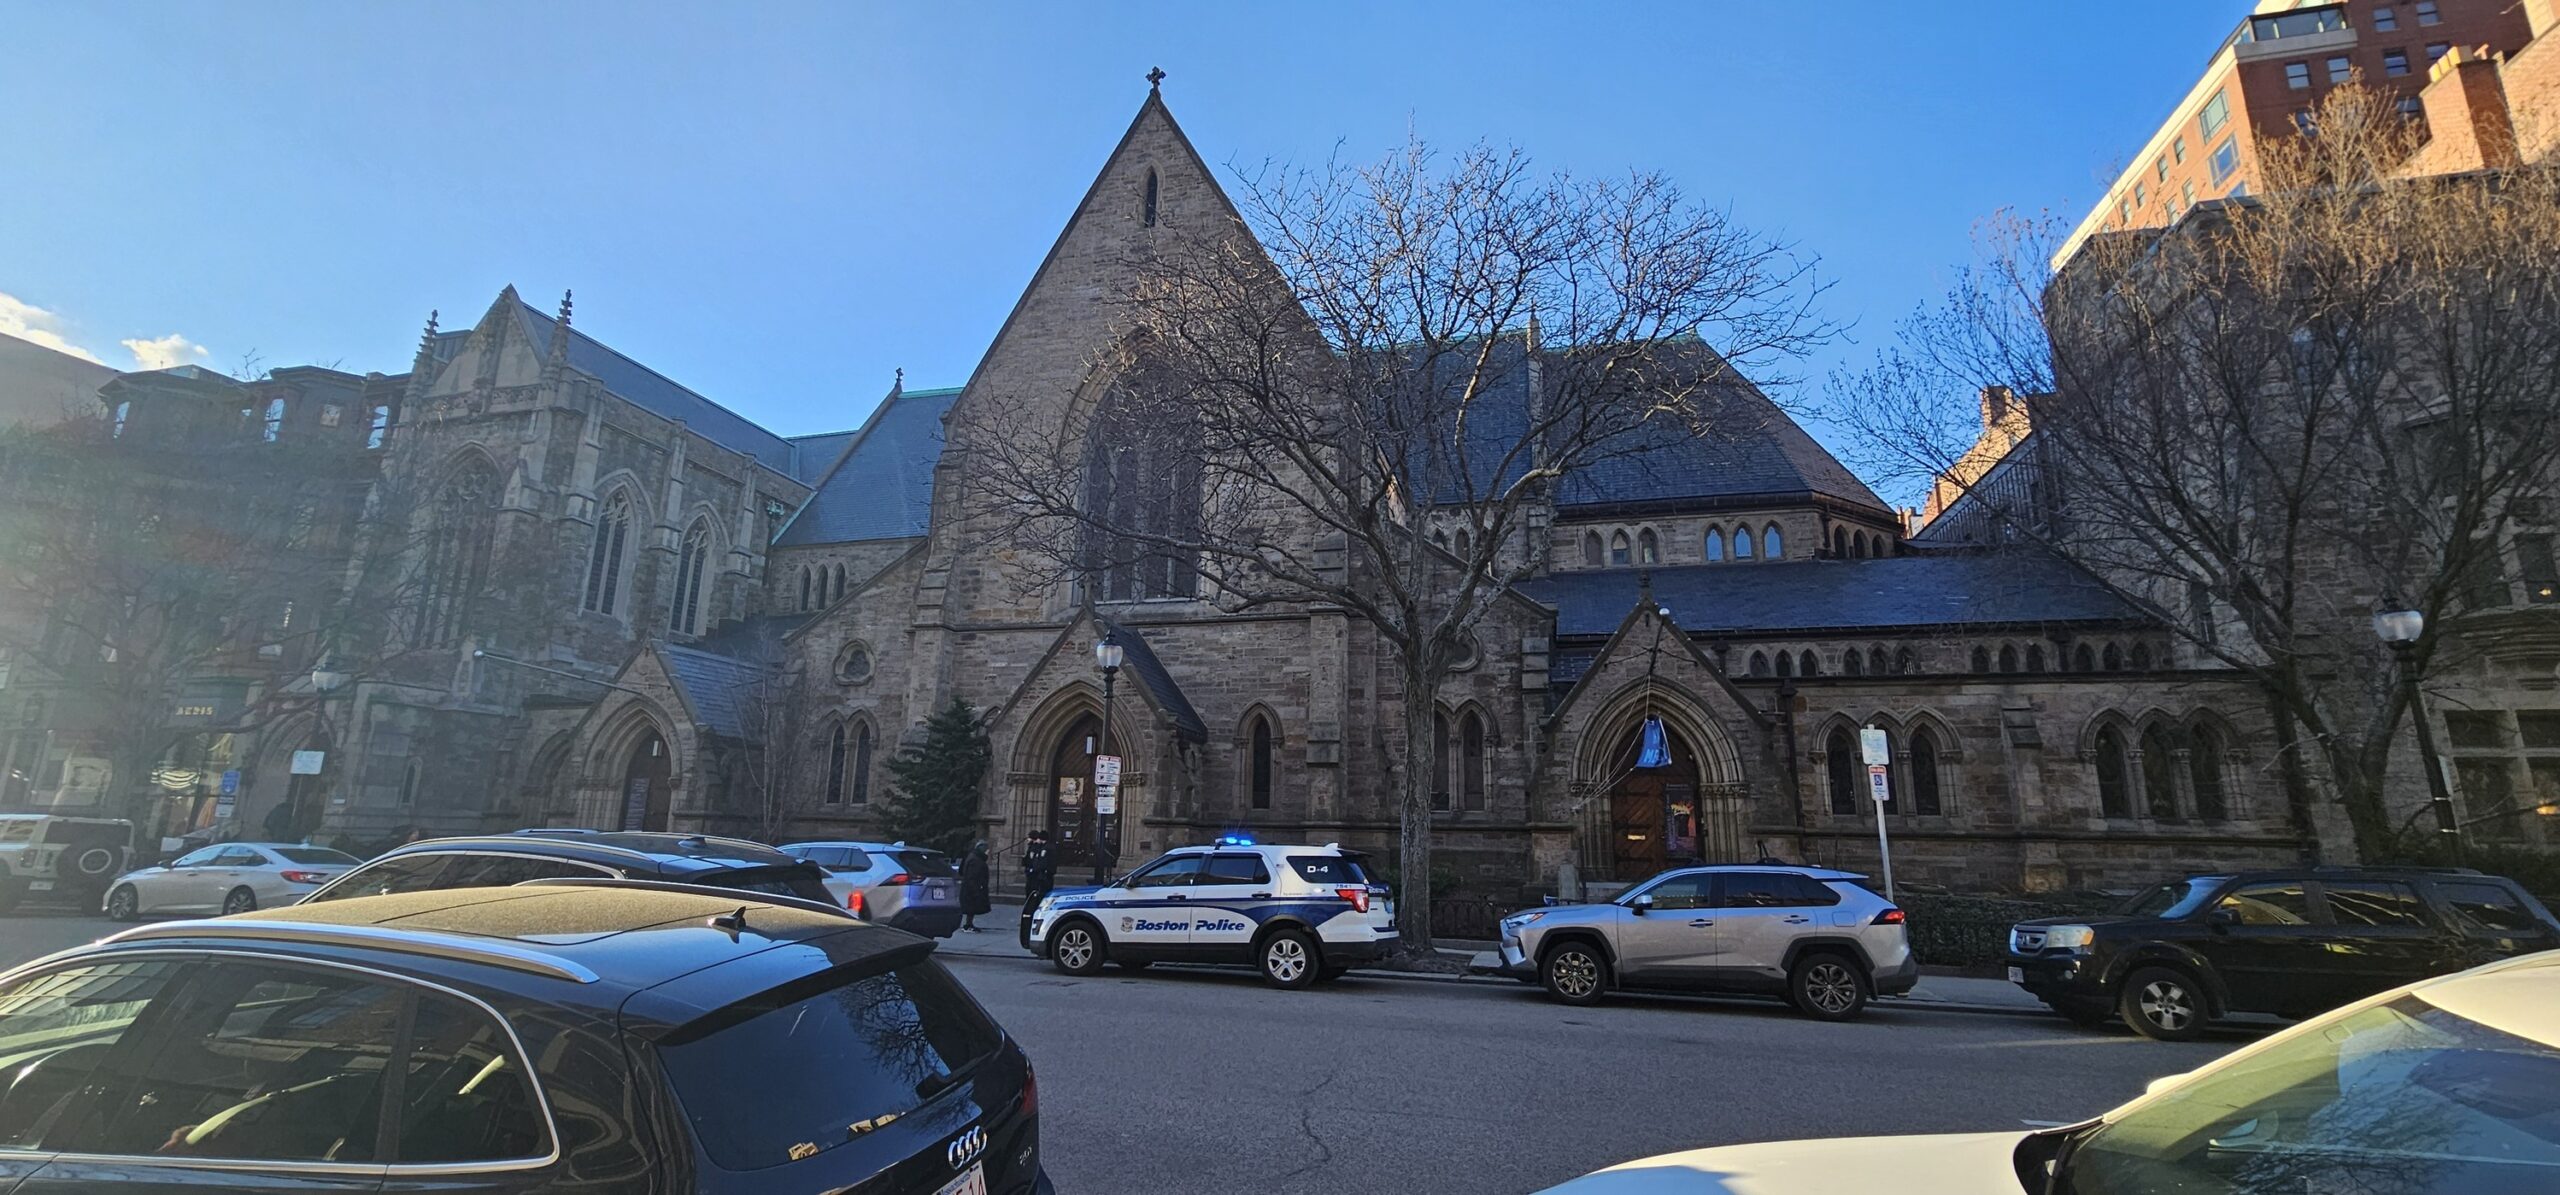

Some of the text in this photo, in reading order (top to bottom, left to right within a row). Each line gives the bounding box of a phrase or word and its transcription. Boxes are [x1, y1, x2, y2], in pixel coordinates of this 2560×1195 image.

[1307, 865, 1328, 873] D-4
[1135, 919, 1246, 931] Boston Police
